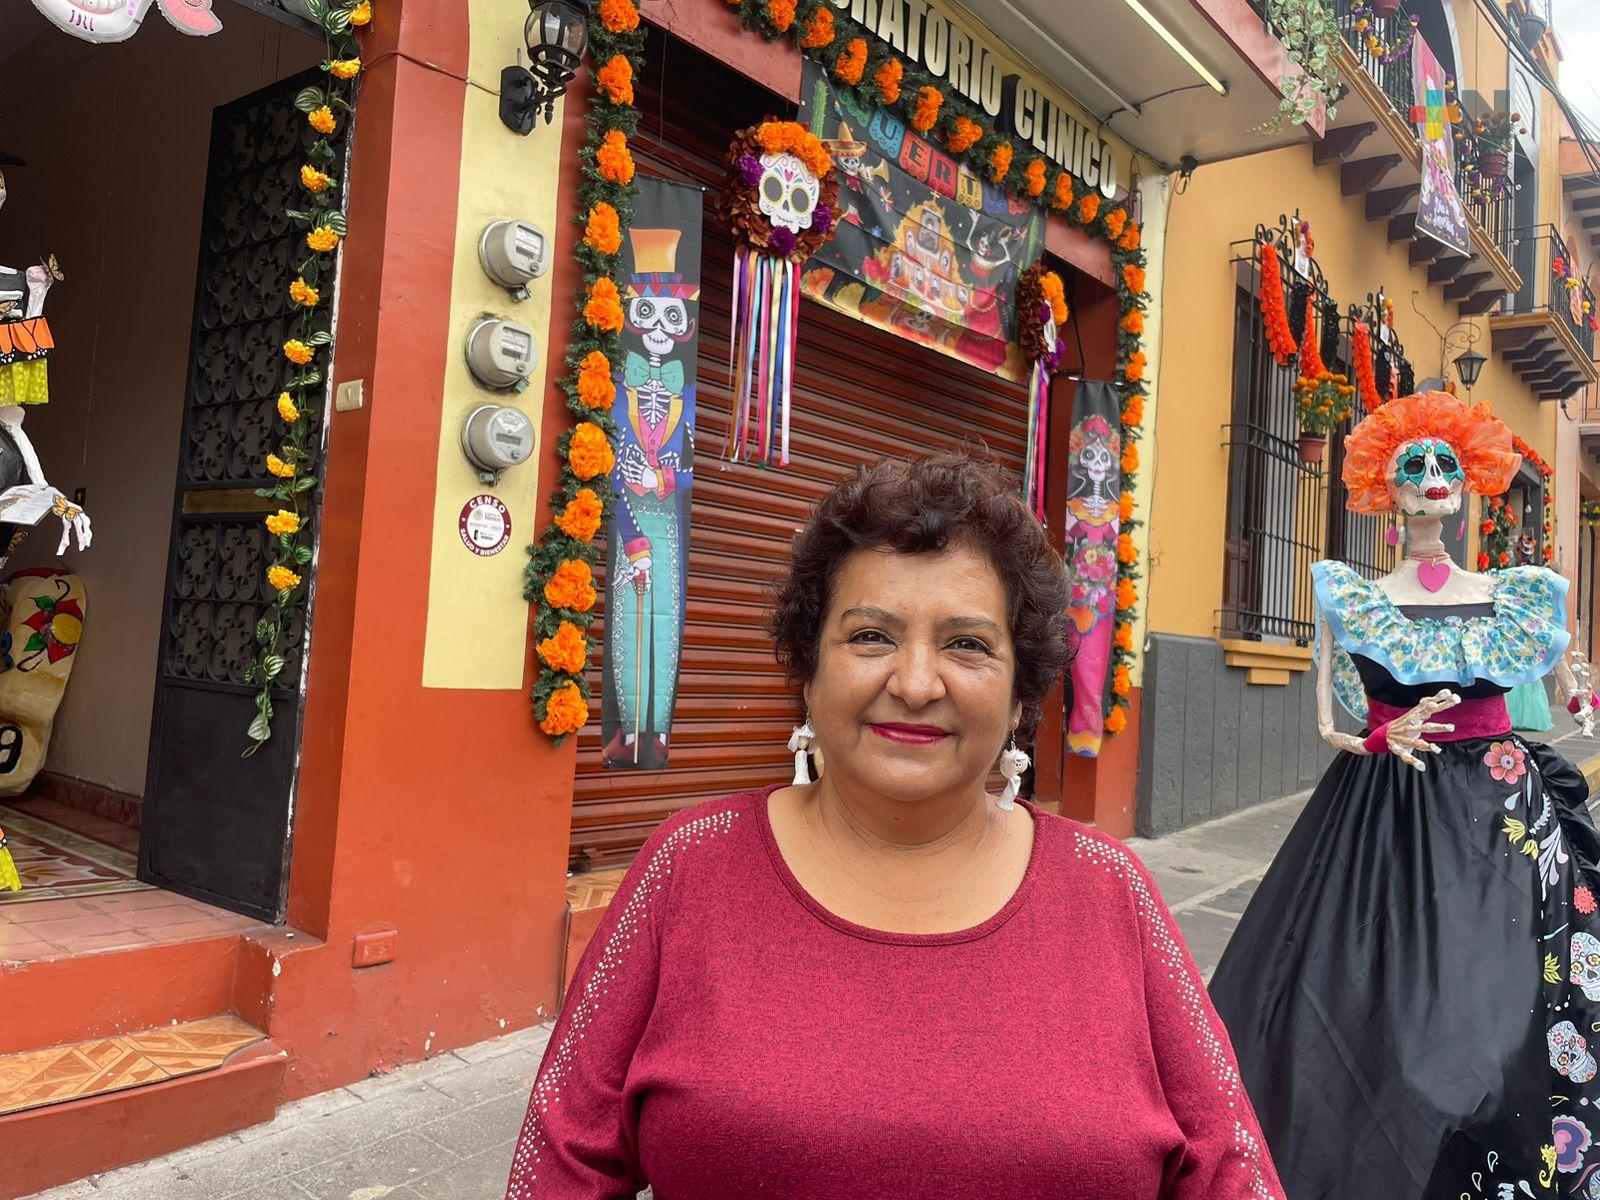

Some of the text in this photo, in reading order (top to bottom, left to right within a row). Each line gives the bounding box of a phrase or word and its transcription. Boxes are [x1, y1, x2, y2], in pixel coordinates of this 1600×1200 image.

[1014, 78, 1117, 199] CLINICO
[469, 496, 505, 513] CENSO
[461, 528, 474, 550] SALUD
[480, 535, 509, 556] BIENESTAR
